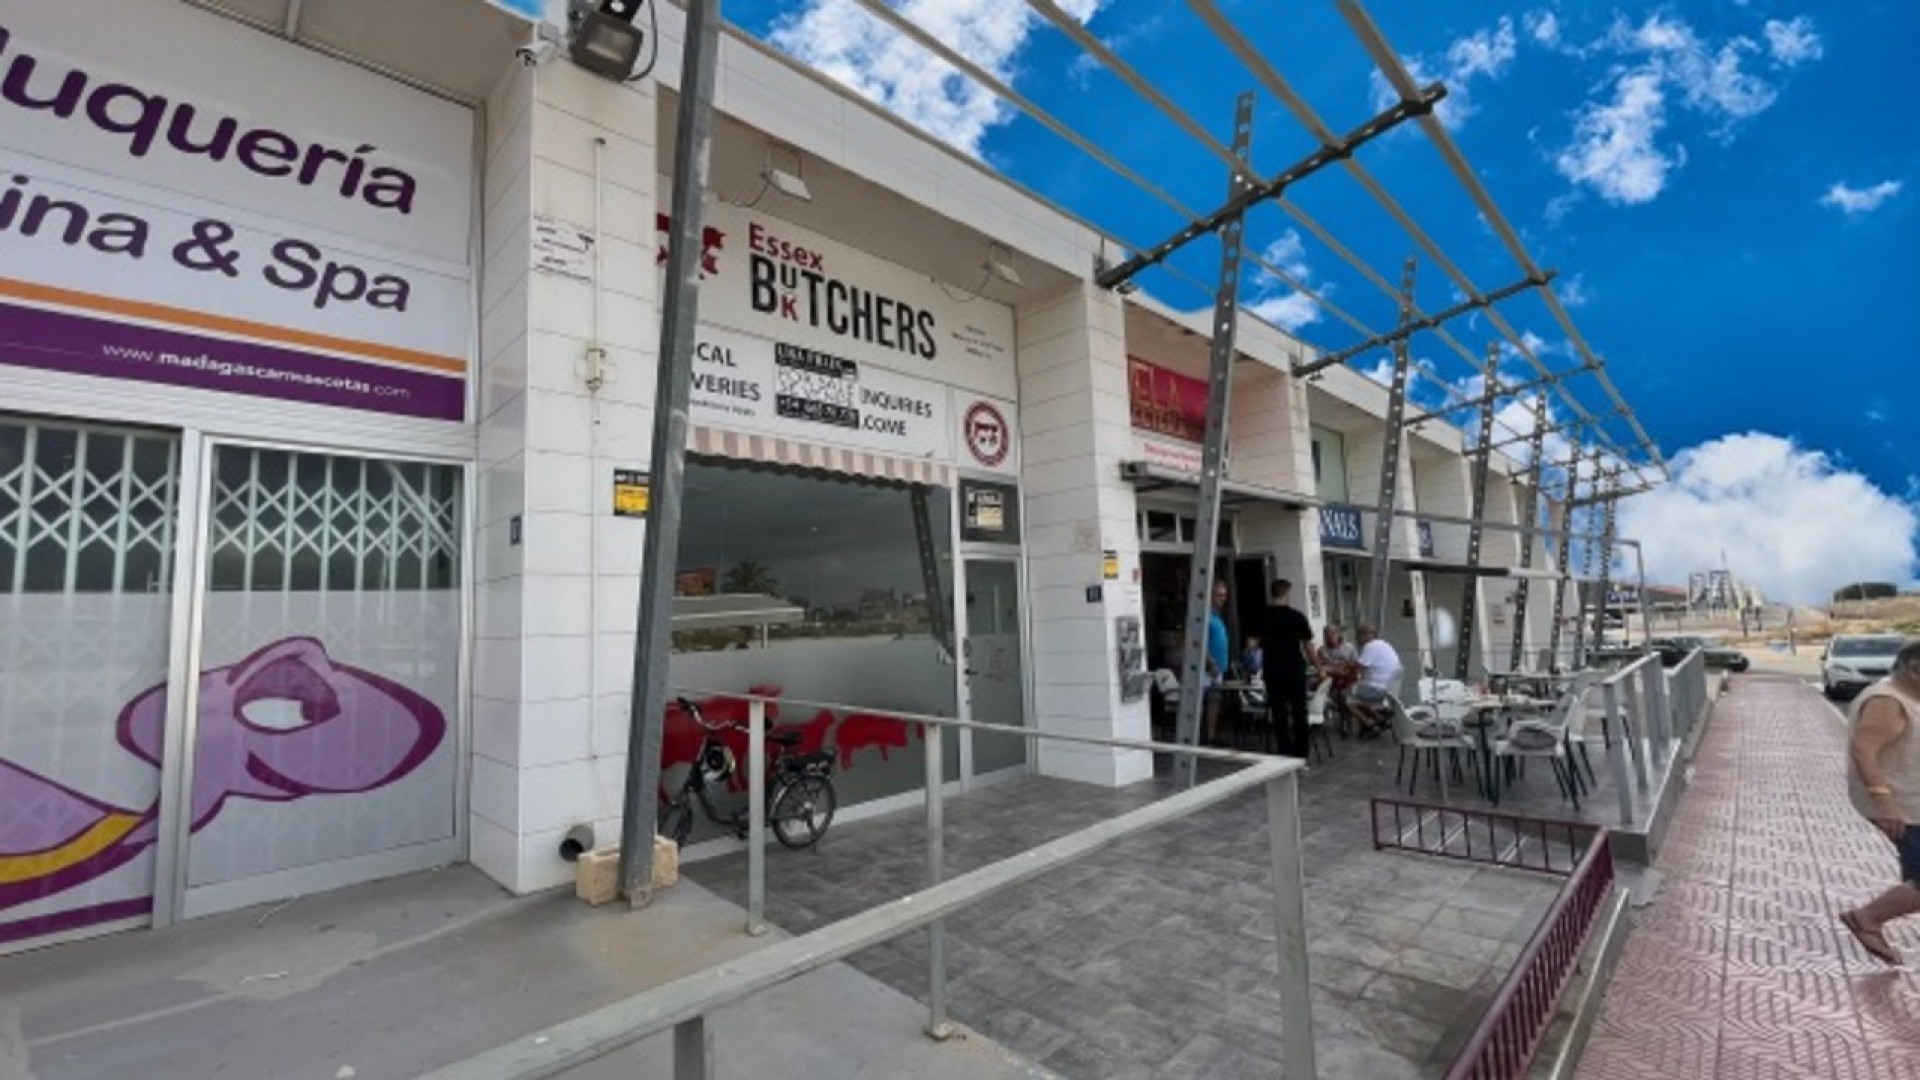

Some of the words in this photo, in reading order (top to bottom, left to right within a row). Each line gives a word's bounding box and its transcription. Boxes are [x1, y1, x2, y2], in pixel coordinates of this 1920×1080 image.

[172, 218, 241, 278] &
[263, 239, 410, 312] Spa
[749, 222, 823, 271] Essex
[752, 254, 936, 360] BUTCHERS
[696, 342, 737, 367] CAL
[691, 372, 762, 402] VERIES
